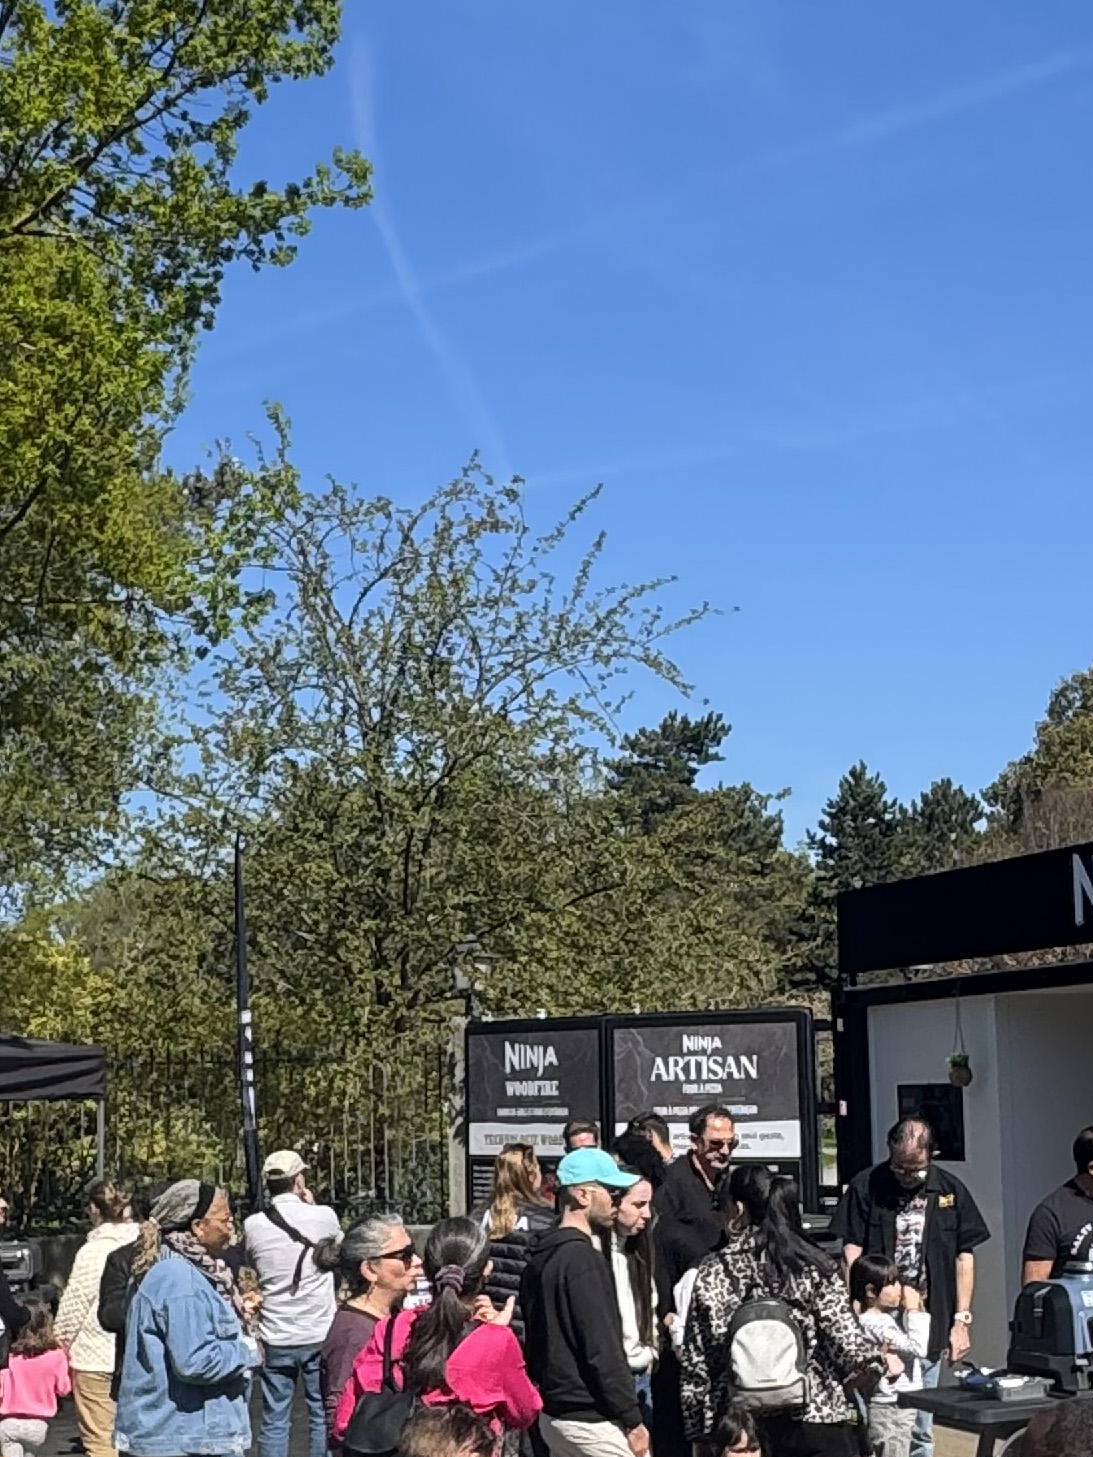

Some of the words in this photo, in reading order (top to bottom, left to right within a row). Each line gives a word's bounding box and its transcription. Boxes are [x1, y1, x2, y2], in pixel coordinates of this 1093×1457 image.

[682, 1034, 722, 1055] NINJA
[504, 1040, 559, 1078] NINJA
[650, 1054, 758, 1082] ARTISAN
